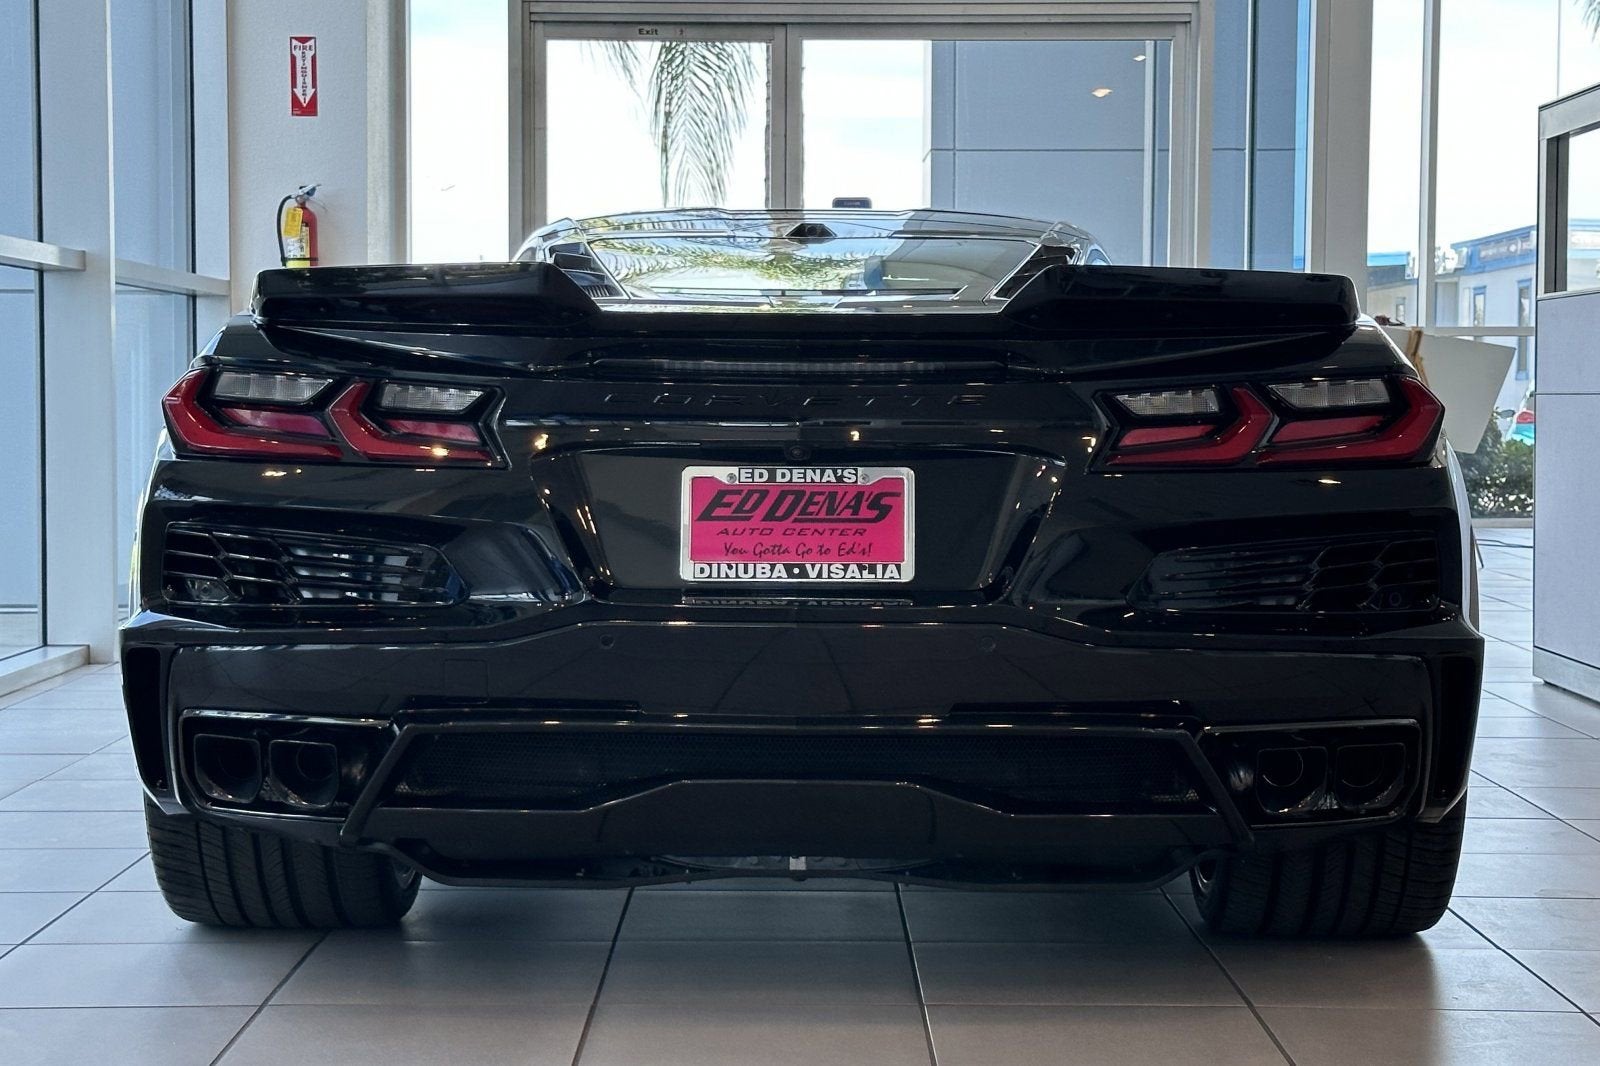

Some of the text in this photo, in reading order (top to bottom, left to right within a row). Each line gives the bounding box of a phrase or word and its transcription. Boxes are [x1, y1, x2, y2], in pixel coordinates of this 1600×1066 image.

[739, 468, 858, 483] ED DENA'S
[695, 489, 902, 524] ED DENA'S
[716, 527, 868, 537] AUTO CENTER
[723, 542, 872, 557] You Gotta Go to Ed's!
[694, 563, 902, 580] DINUBA VISALIA
